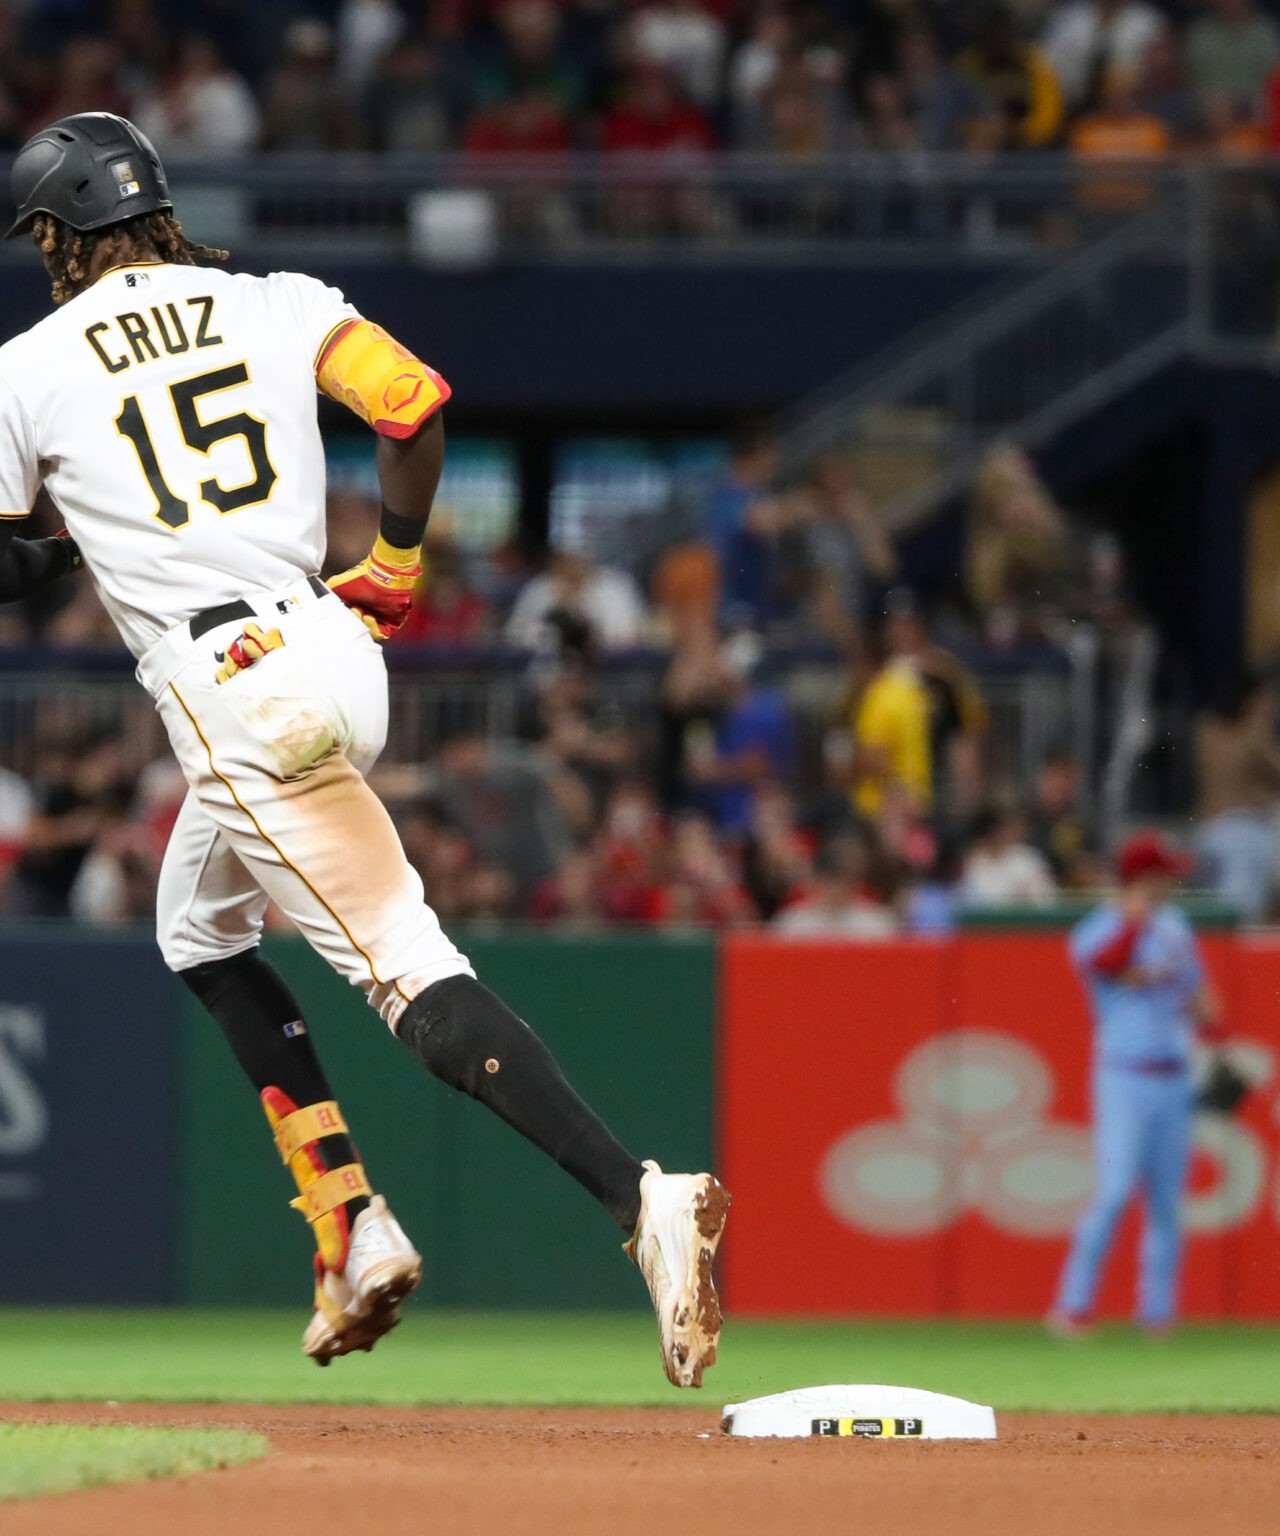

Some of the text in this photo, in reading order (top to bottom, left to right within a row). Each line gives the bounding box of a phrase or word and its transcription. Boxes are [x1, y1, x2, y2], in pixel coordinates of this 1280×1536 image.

[84, 295, 224, 375] CRUZ
[112, 360, 280, 531] 15
[819, 1420, 831, 1435] P
[903, 1419, 915, 1434] P
